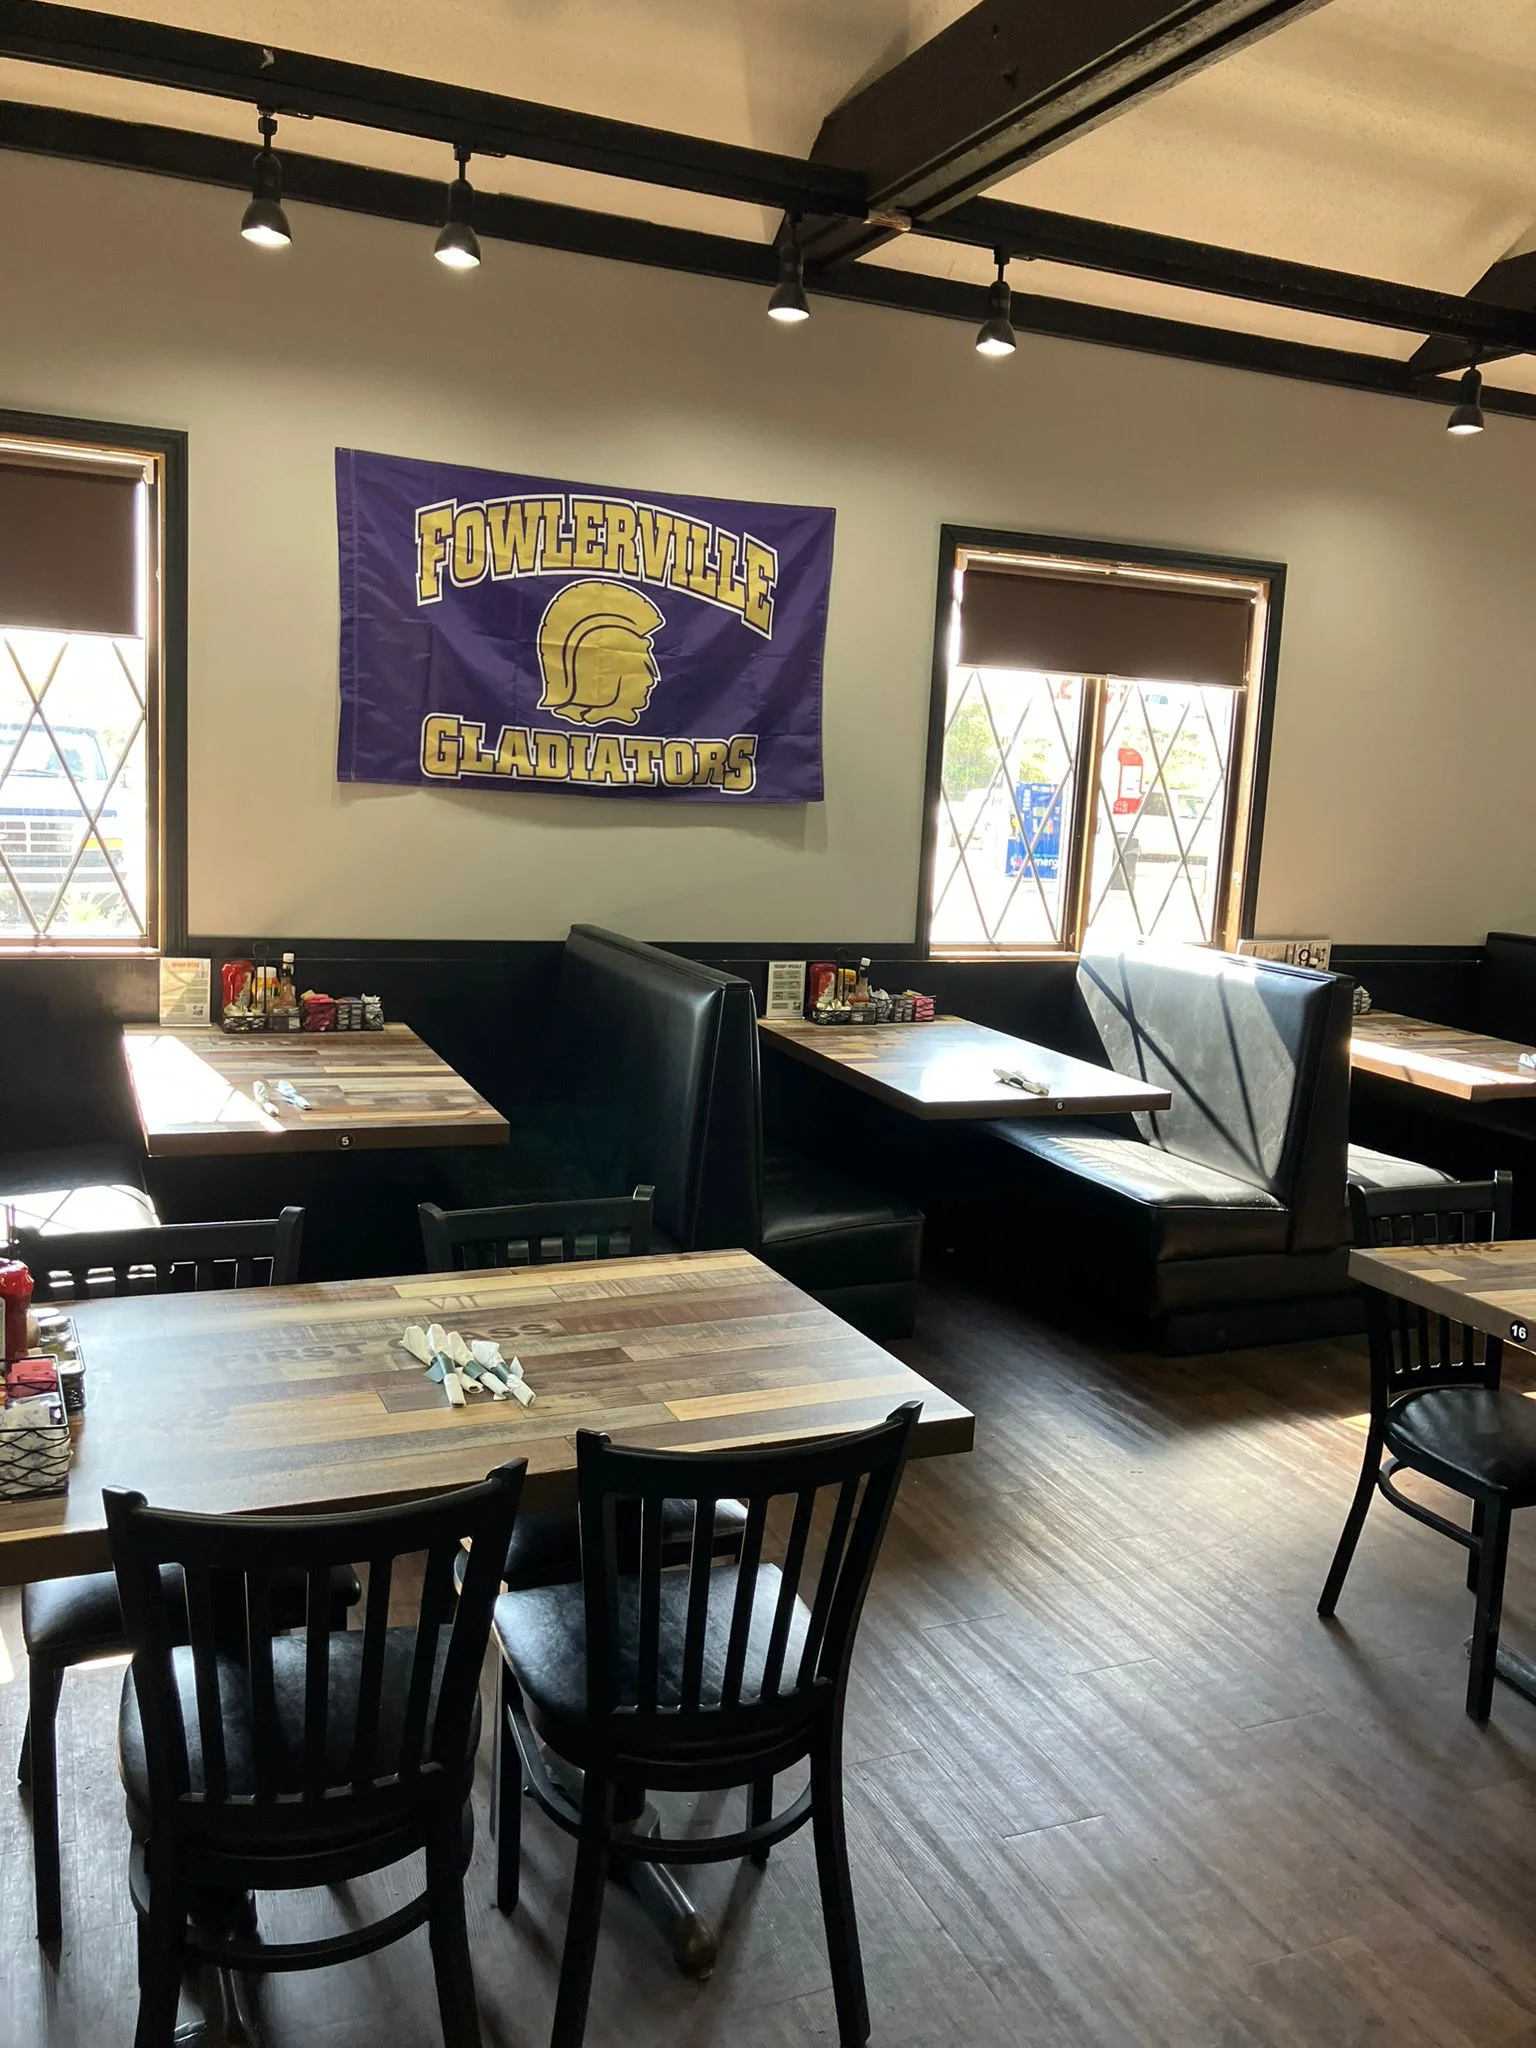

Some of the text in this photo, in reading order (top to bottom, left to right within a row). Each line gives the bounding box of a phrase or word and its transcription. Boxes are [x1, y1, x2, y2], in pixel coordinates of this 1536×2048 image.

[415, 493, 778, 639] FOWLERVILLE
[420, 713, 758, 794] GLADIATORS
[341, 1136, 349, 1146] 5
[423, 1294, 480, 1311] VII
[1511, 1324, 1527, 1340] 16
